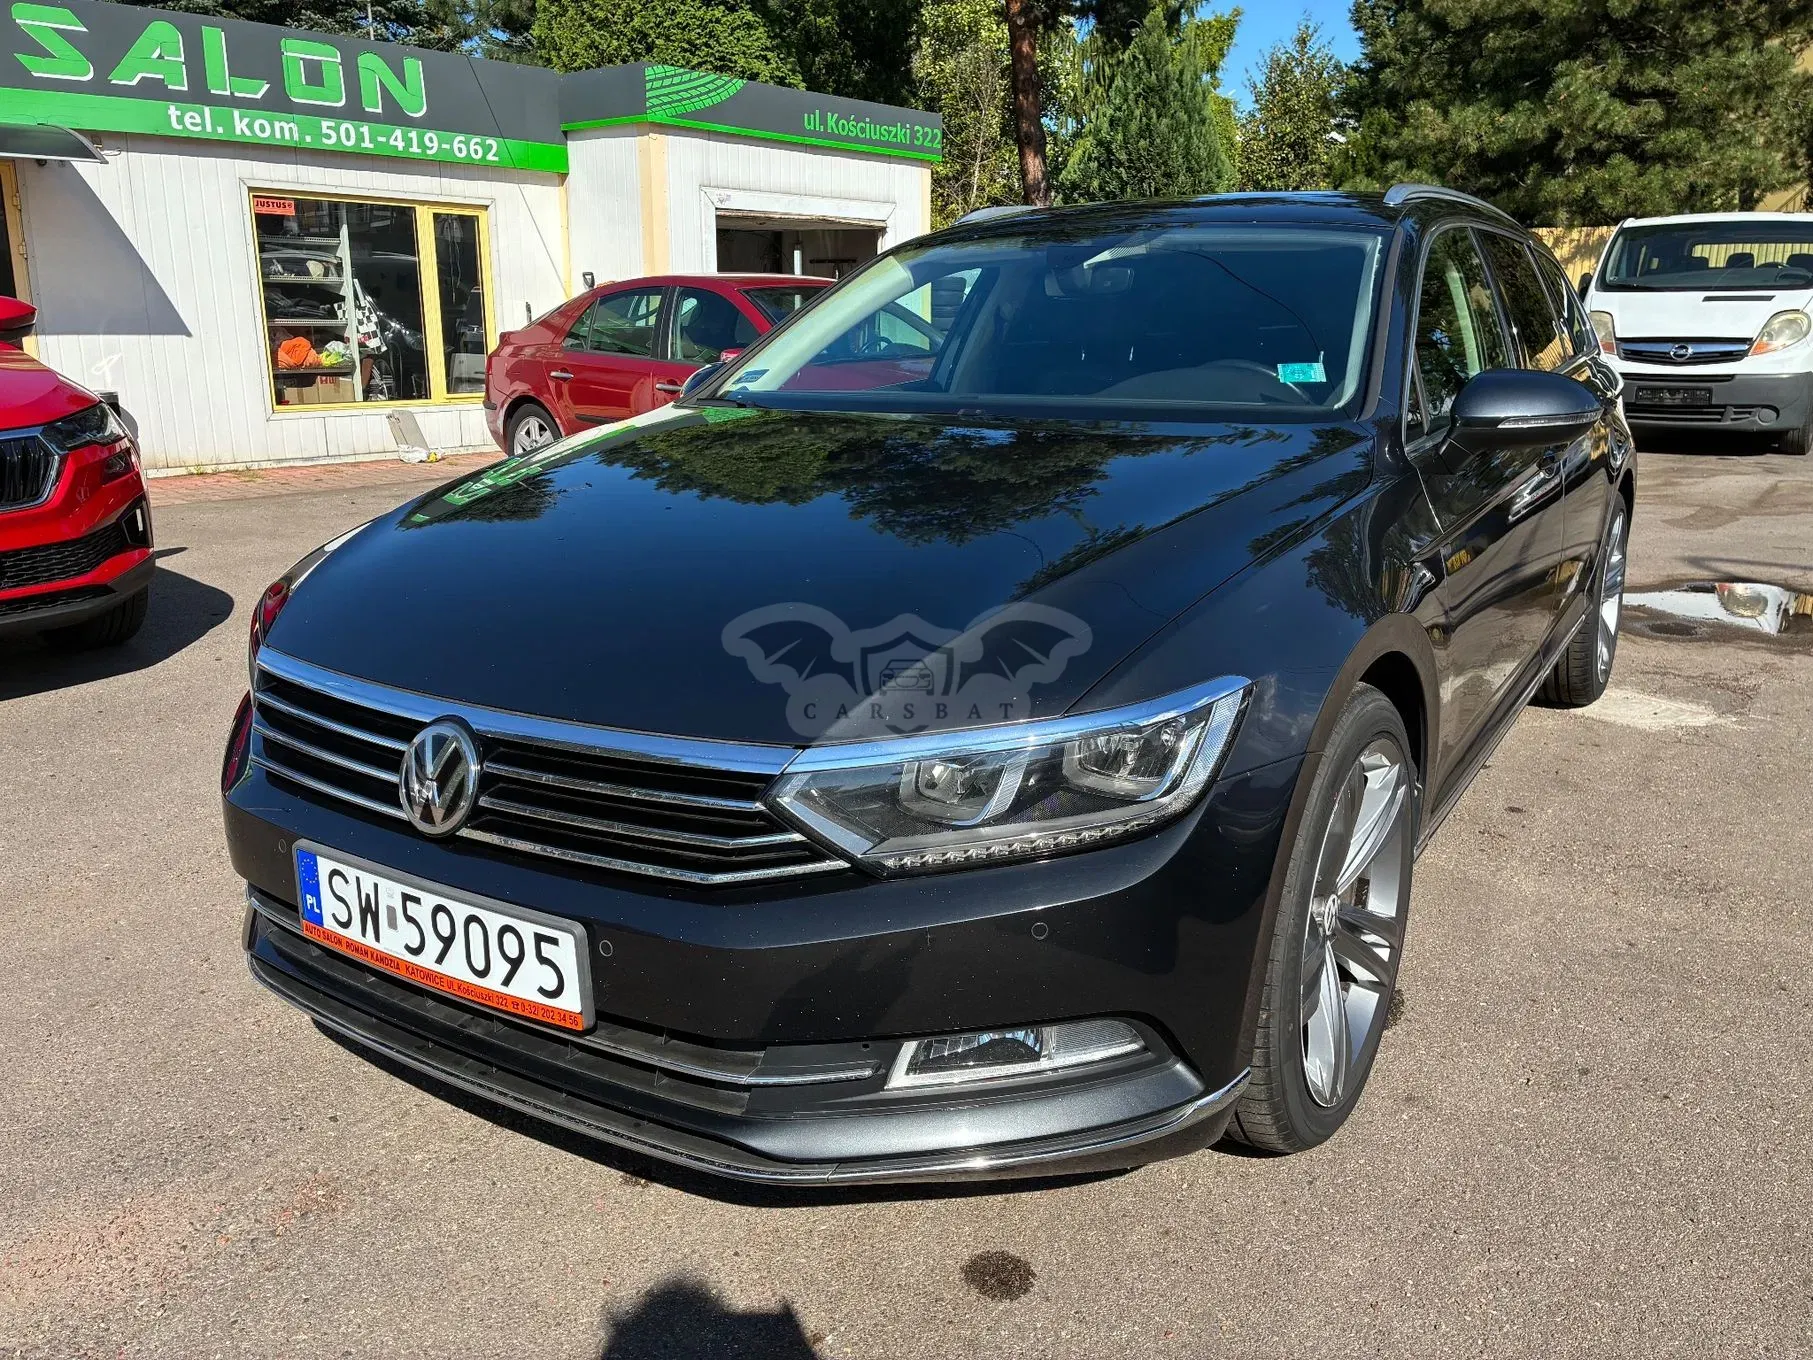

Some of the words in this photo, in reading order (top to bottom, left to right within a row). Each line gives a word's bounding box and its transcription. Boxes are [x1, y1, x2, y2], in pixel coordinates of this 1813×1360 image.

[11, 2, 428, 118] SALON
[168, 104, 224, 134] tel.
[320, 120, 500, 161] 501-419-662
[803, 109, 824, 132] ul.
[827, 112, 910, 144] Kościuszki
[914, 125, 942, 149] 322
[255, 199, 287, 209] JUSTUS
[306, 895, 320, 914] PL
[328, 868, 381, 944] SW
[401, 891, 566, 1000] 59095
[305, 923, 321, 938] AUTO
[322, 930, 343, 947] SALON
[405, 964, 445, 987] KATOWICE
[496, 995, 509, 1008] 322
[541, 1007, 555, 1021] 202
[557, 1011, 566, 1023] 34
[568, 1015, 579, 1027] 56
